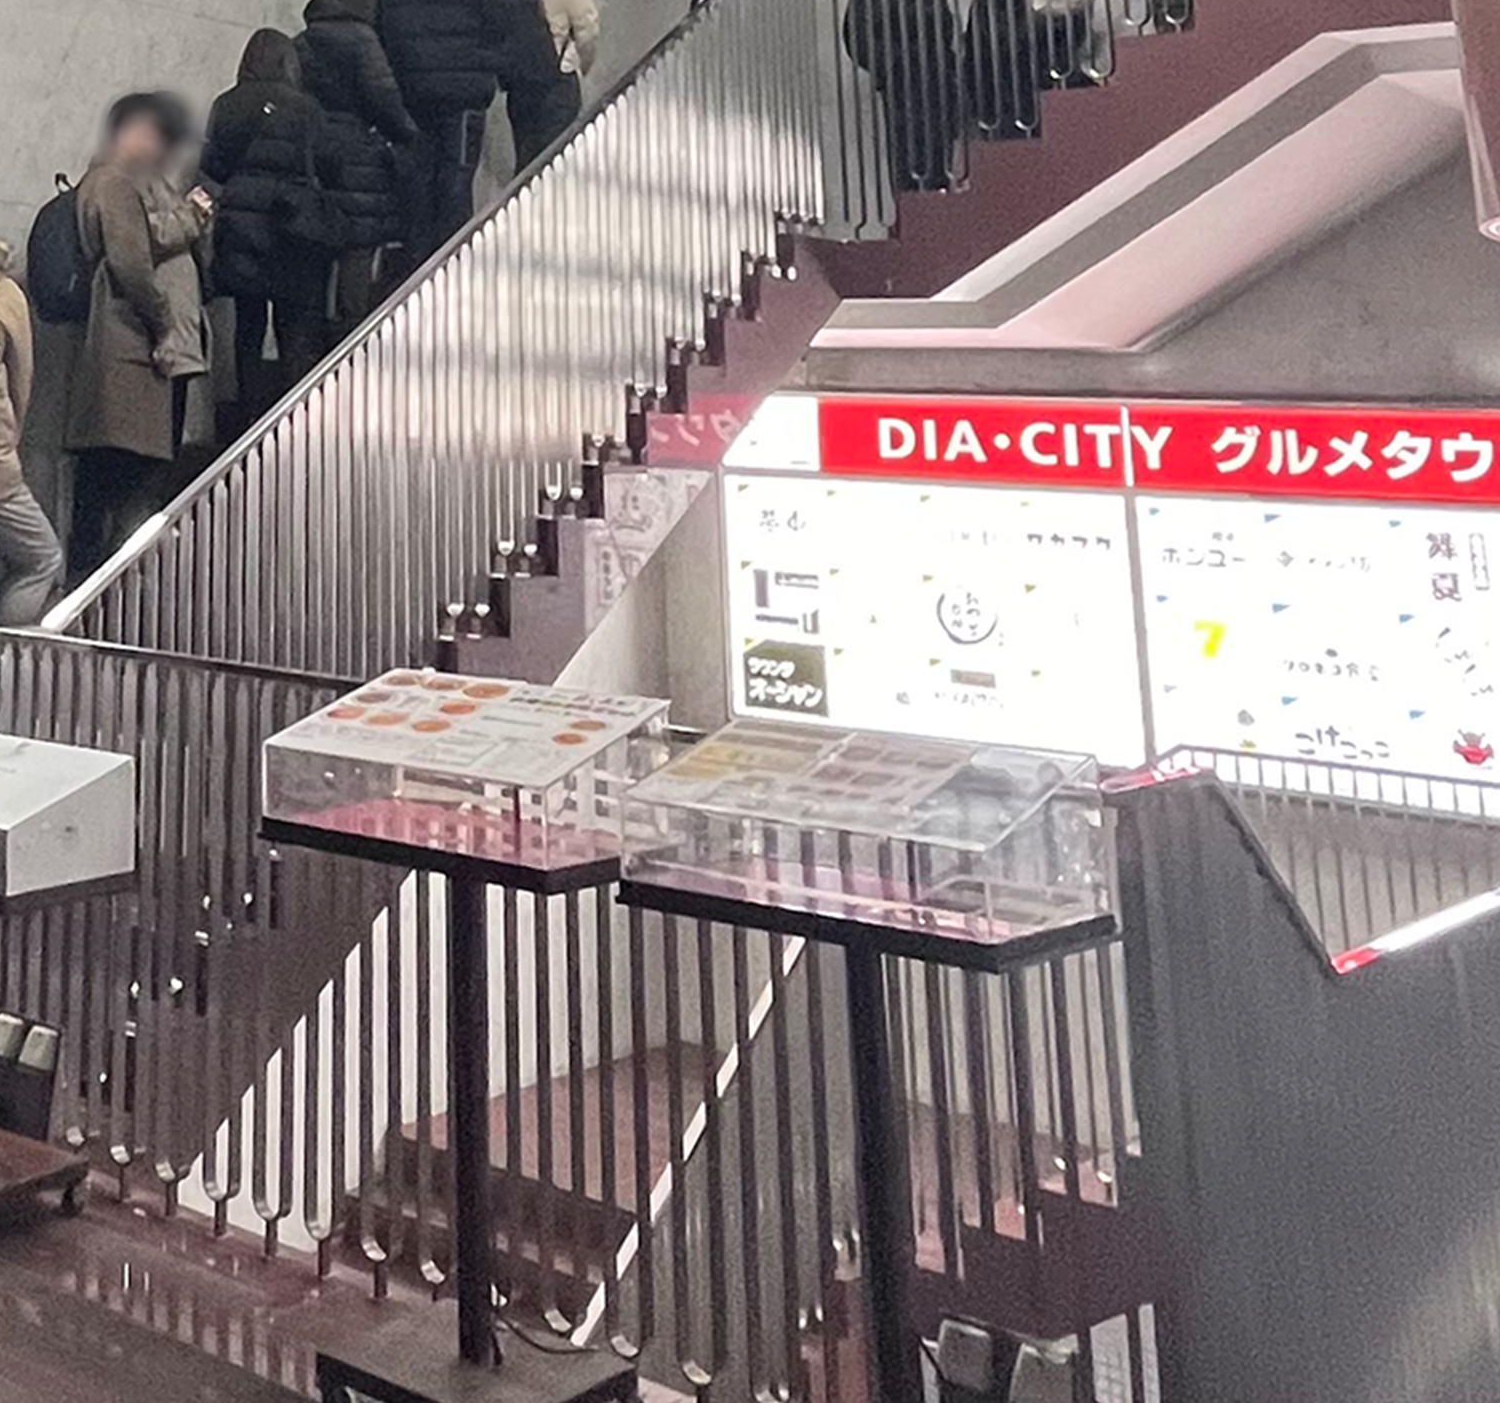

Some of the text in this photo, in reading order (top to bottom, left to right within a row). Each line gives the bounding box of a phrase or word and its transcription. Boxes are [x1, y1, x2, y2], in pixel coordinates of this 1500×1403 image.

[1210, 425, 1494, 483] グルメタウ
